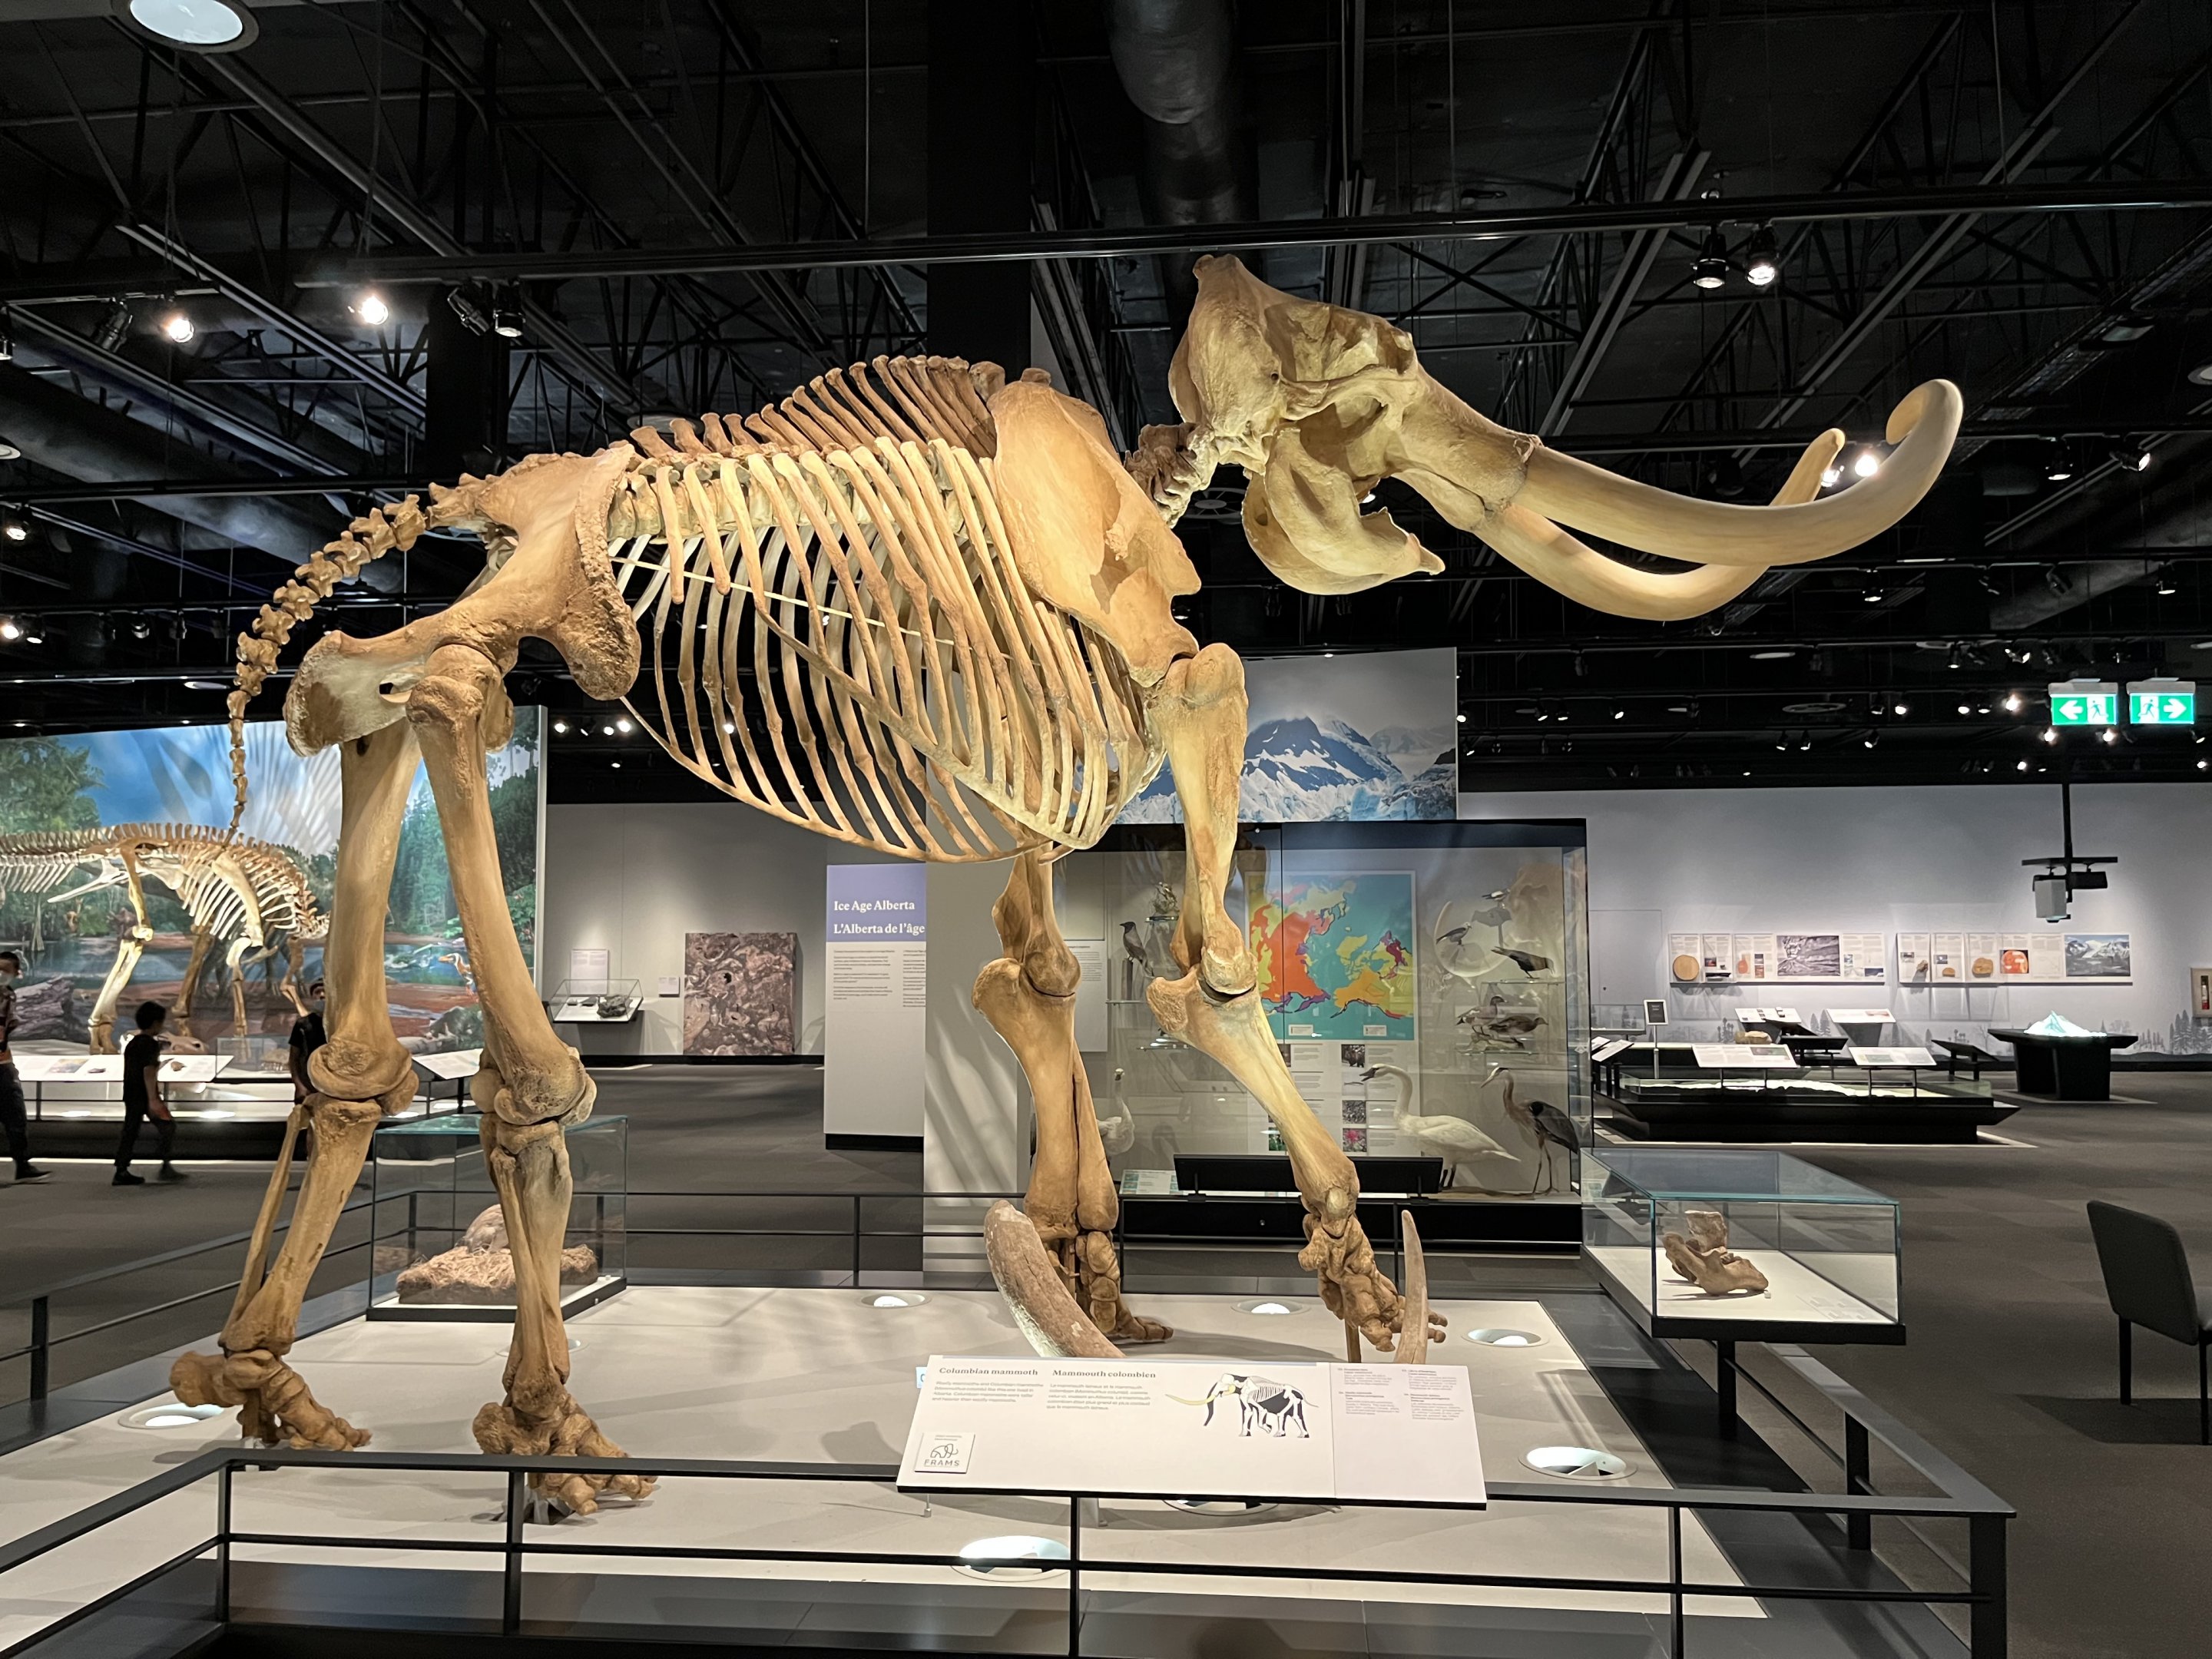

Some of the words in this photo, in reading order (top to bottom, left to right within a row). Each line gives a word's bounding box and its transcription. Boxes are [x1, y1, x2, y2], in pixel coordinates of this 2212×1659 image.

[833, 901, 849, 911] Ice
[852, 901, 873, 913] Age
[873, 900, 915, 911] Alberta
[833, 923, 883, 934] L'Alberta
[885, 923, 898, 934] de
